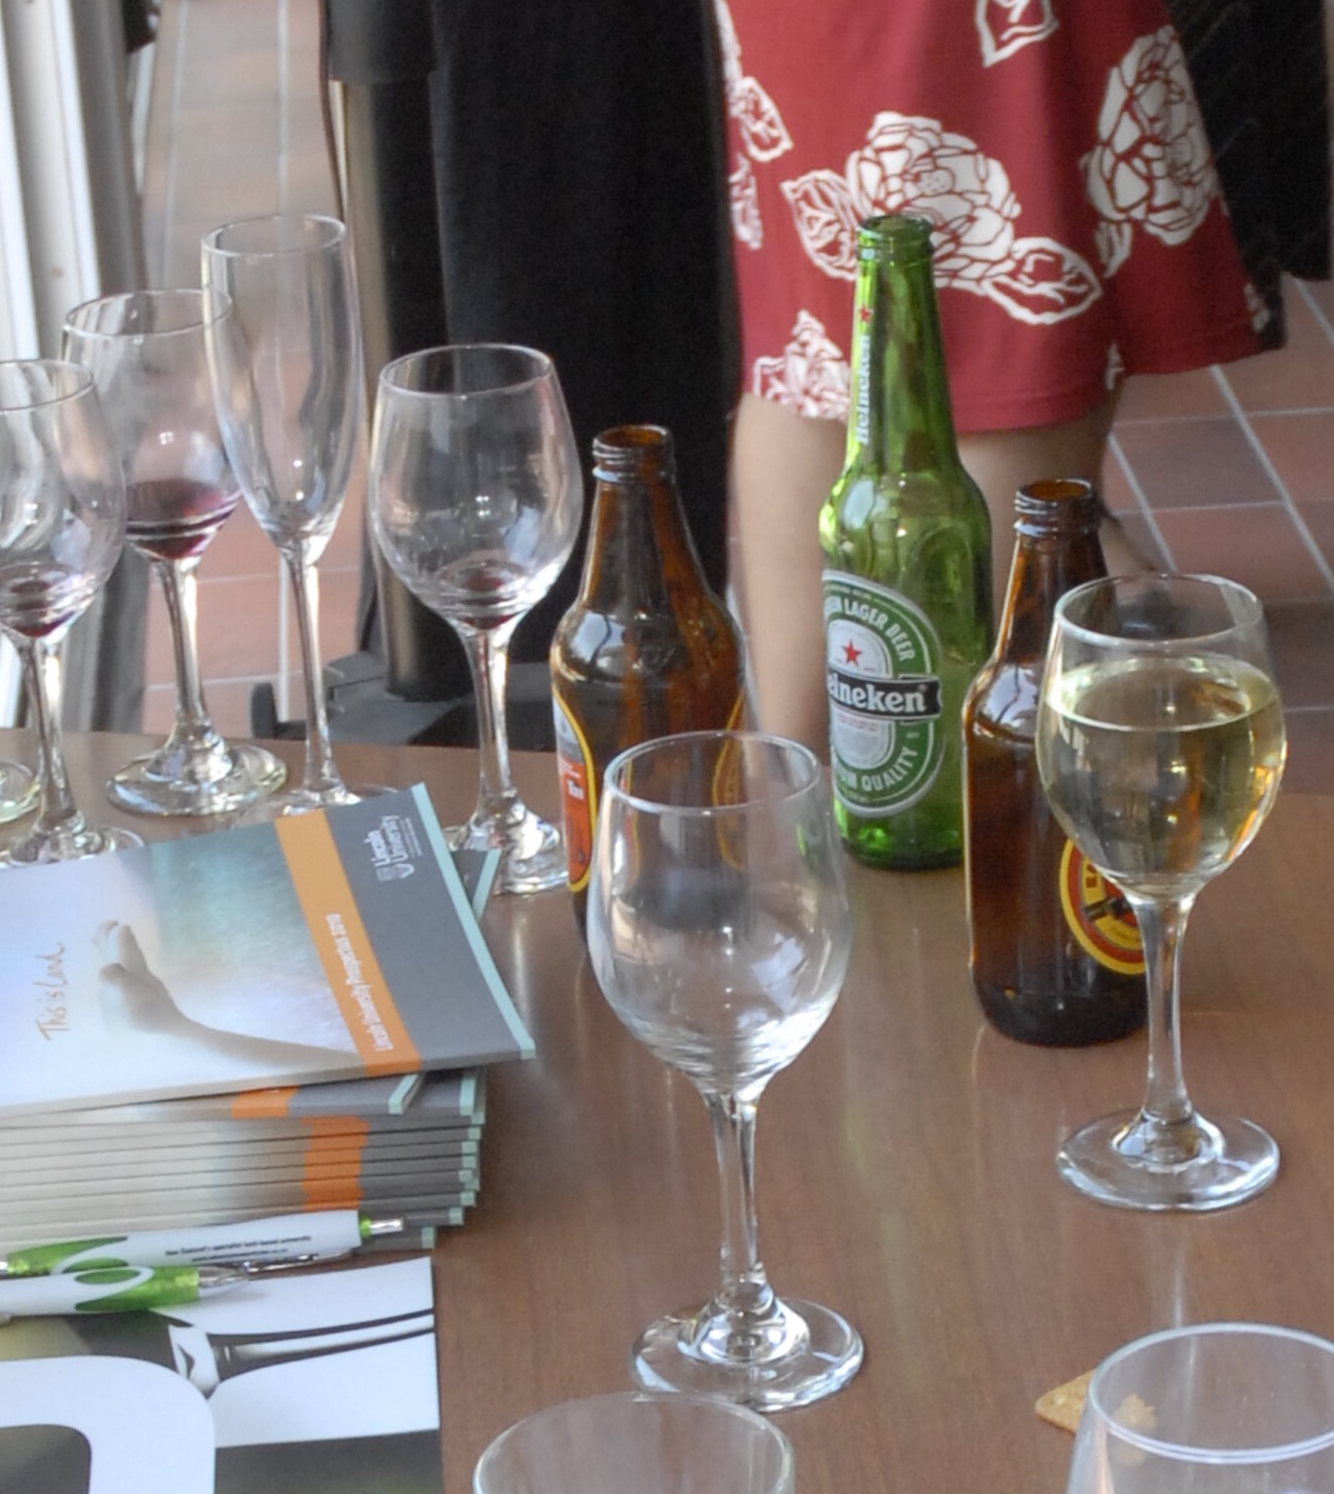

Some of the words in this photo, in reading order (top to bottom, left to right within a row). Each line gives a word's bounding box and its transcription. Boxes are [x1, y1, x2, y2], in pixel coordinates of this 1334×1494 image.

[855, 334, 870, 446] Heineken
[843, 598, 889, 630] LAGER
[885, 623, 915, 662] BEER
[827, 672, 927, 713] eineken
[861, 745, 918, 793] QUALITY
[364, 830, 390, 866] Lincoln
